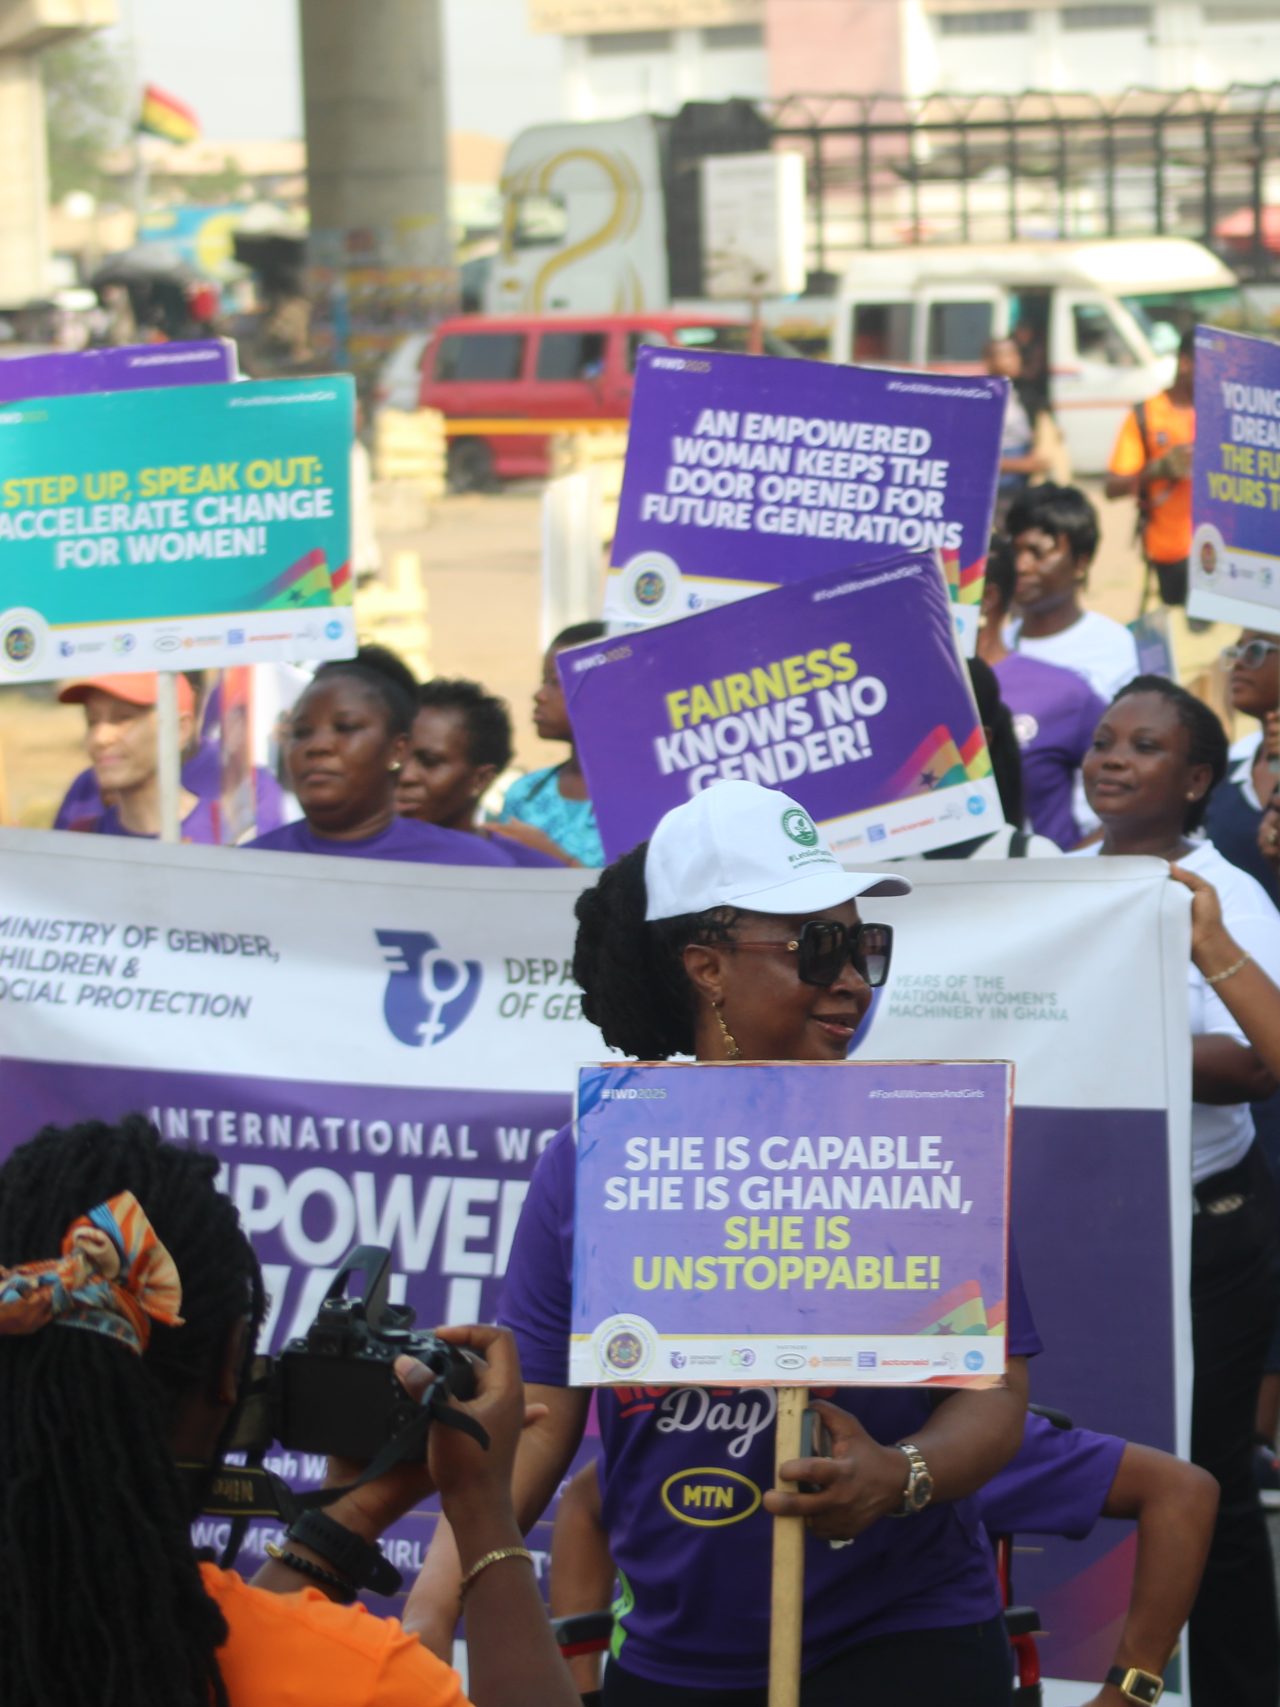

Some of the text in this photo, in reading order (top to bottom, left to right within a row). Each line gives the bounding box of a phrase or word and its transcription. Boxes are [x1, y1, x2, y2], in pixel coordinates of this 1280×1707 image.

[694, 409, 932, 456] AN EMPOWERED
[673, 437, 950, 488] WOMAN KEEPS THE
[1220, 443, 1254, 471] THE
[3, 456, 323, 508] STEP UP, SPEAK OUT:
[667, 467, 944, 518] DOOR OPENED FOR
[1208, 473, 1267, 507] YOURS
[0, 488, 333, 539] ACCELERATE CHANGE
[642, 495, 963, 549] FUTURE GENERATIONS
[56, 527, 268, 569] FOR WOMEN!
[666, 643, 857, 729] FAIRNESS
[655, 677, 888, 775] KNOWS NO
[688, 720, 873, 796] GENDER!
[0, 947, 141, 979] HILDREN &
[123, 924, 160, 949] OF
[167, 928, 280, 963] GENDER,
[76, 983, 252, 1020] PROTECTION
[889, 989, 1058, 1006] NATIONAL WOMEN'S
[896, 975, 1005, 990] YEARS OF THE
[498, 991, 539, 1019] OF
[888, 1004, 1069, 1023] MACHINERY IN GHANA
[601, 1089, 667, 1100] #IWD2025
[150, 1106, 479, 1159] INTERNATIONAL
[625, 1135, 954, 1174] SHE IS CAPABLE,
[604, 1175, 973, 1214] SHE IS GHANAIAN,
[724, 1216, 851, 1250] SHE IS
[632, 1256, 941, 1290] UNSTOPPABLE!
[656, 1386, 777, 1458] Day
[682, 1485, 734, 1509] MTN
